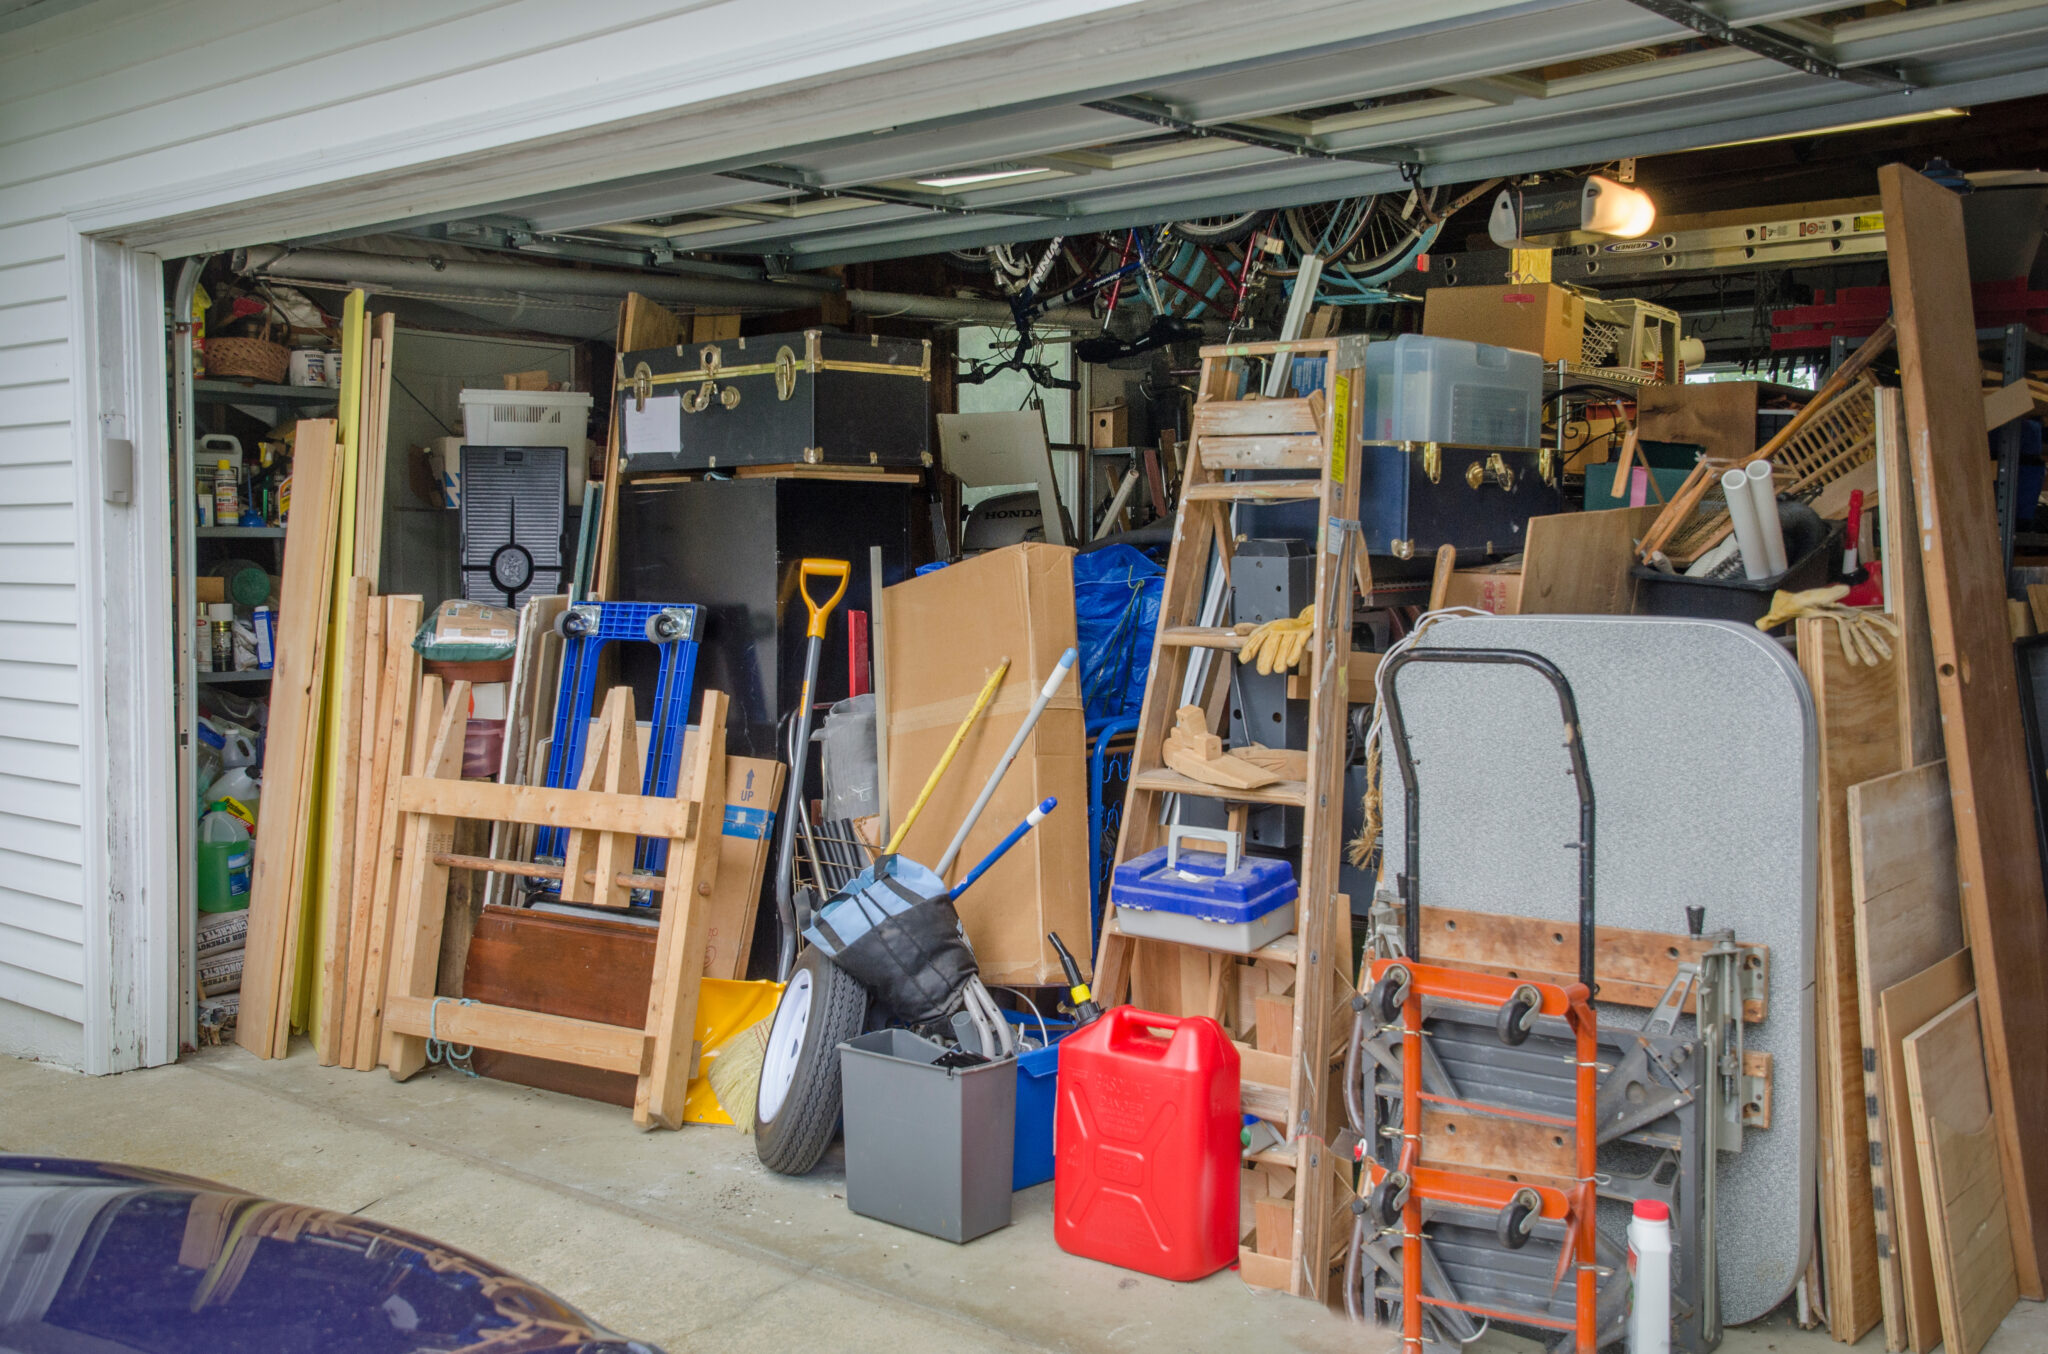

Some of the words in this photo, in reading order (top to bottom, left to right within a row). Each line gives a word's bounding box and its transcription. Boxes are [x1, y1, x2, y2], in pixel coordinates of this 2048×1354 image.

[1615, 241, 1649, 251] WERNER
[984, 508, 1042, 520] HONDA
[740, 790, 755, 802] UP
[204, 920, 248, 942] CONCRETE
[1096, 1072, 1152, 1100] GASOLINE
[1099, 1095, 1144, 1113] DANGER
